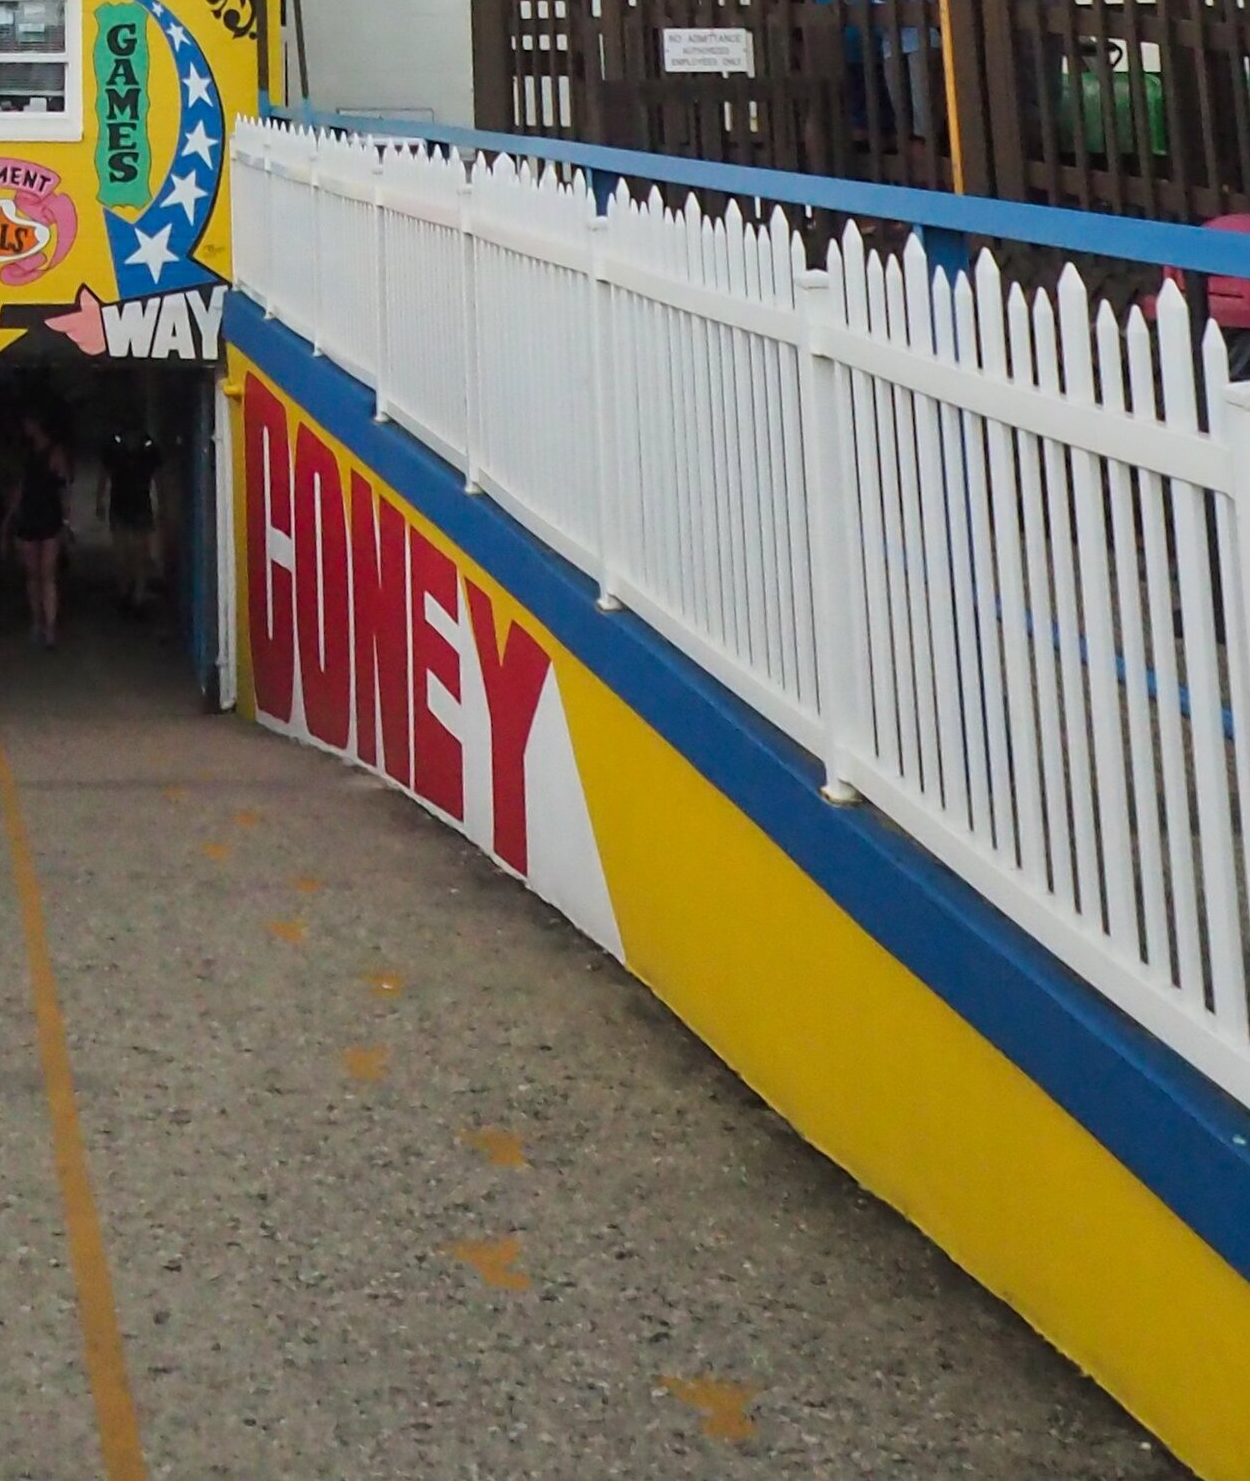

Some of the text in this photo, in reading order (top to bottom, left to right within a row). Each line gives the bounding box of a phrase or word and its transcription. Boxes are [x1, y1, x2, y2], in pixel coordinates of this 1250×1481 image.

[105, 23, 140, 184] GAMES
[101, 284, 229, 361] WAY
[244, 371, 551, 877] CONEY
